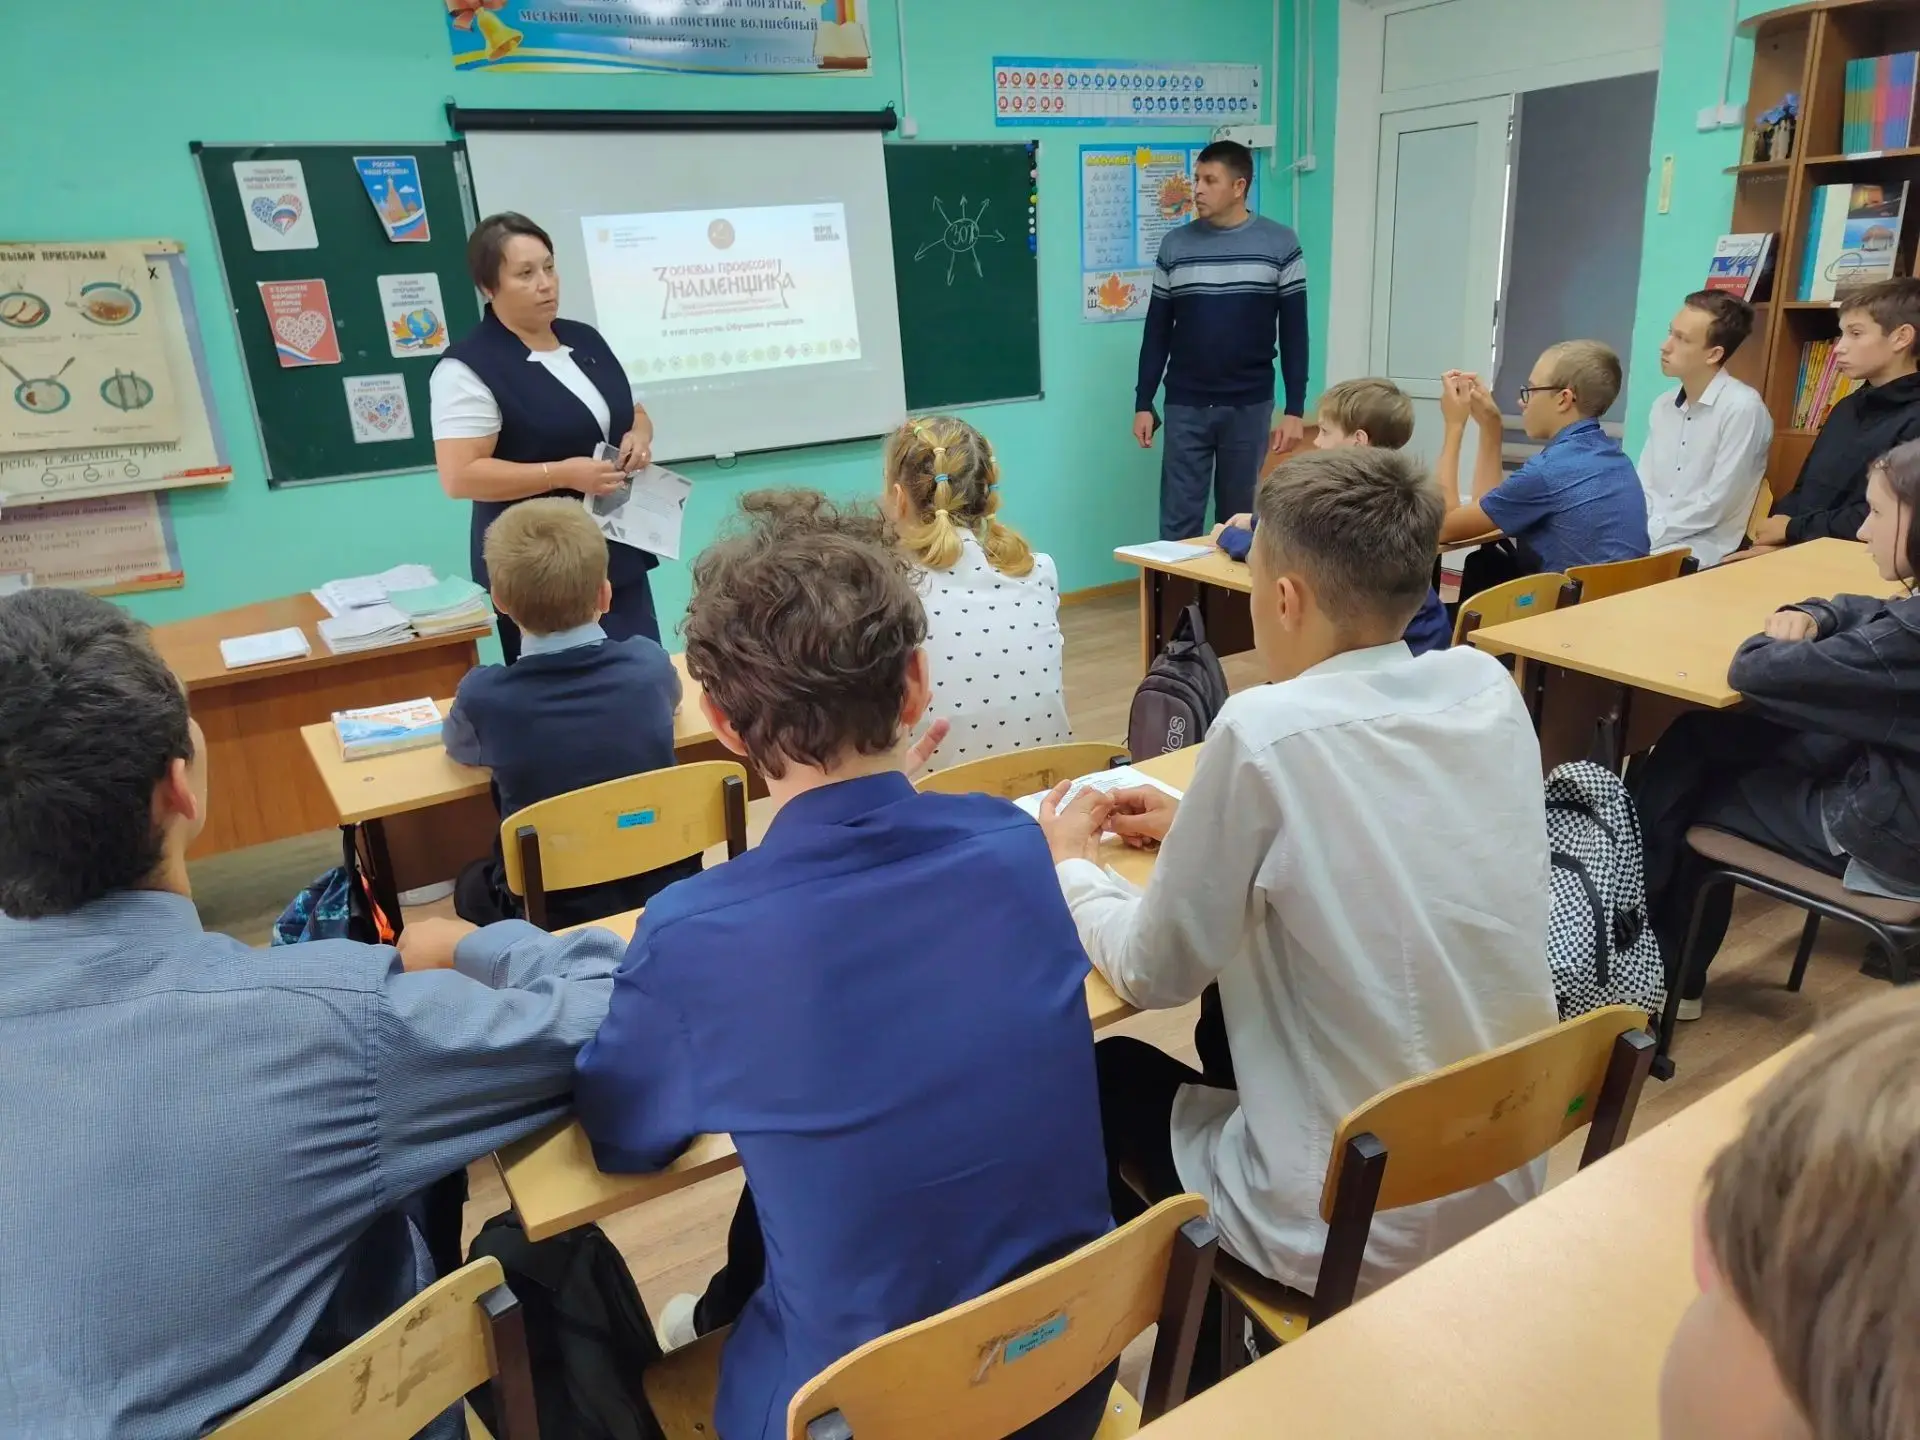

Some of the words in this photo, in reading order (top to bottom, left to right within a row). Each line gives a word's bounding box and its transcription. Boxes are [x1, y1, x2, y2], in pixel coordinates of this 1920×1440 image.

[669, 15, 737, 29] поистине
[740, 16, 819, 31] волшебный
[691, 36, 731, 49] язык.
[40, 250, 107, 262] ПРИБОРАМИ
[60, 448, 124, 465] жасмин,
[142, 441, 183, 458] розы.
